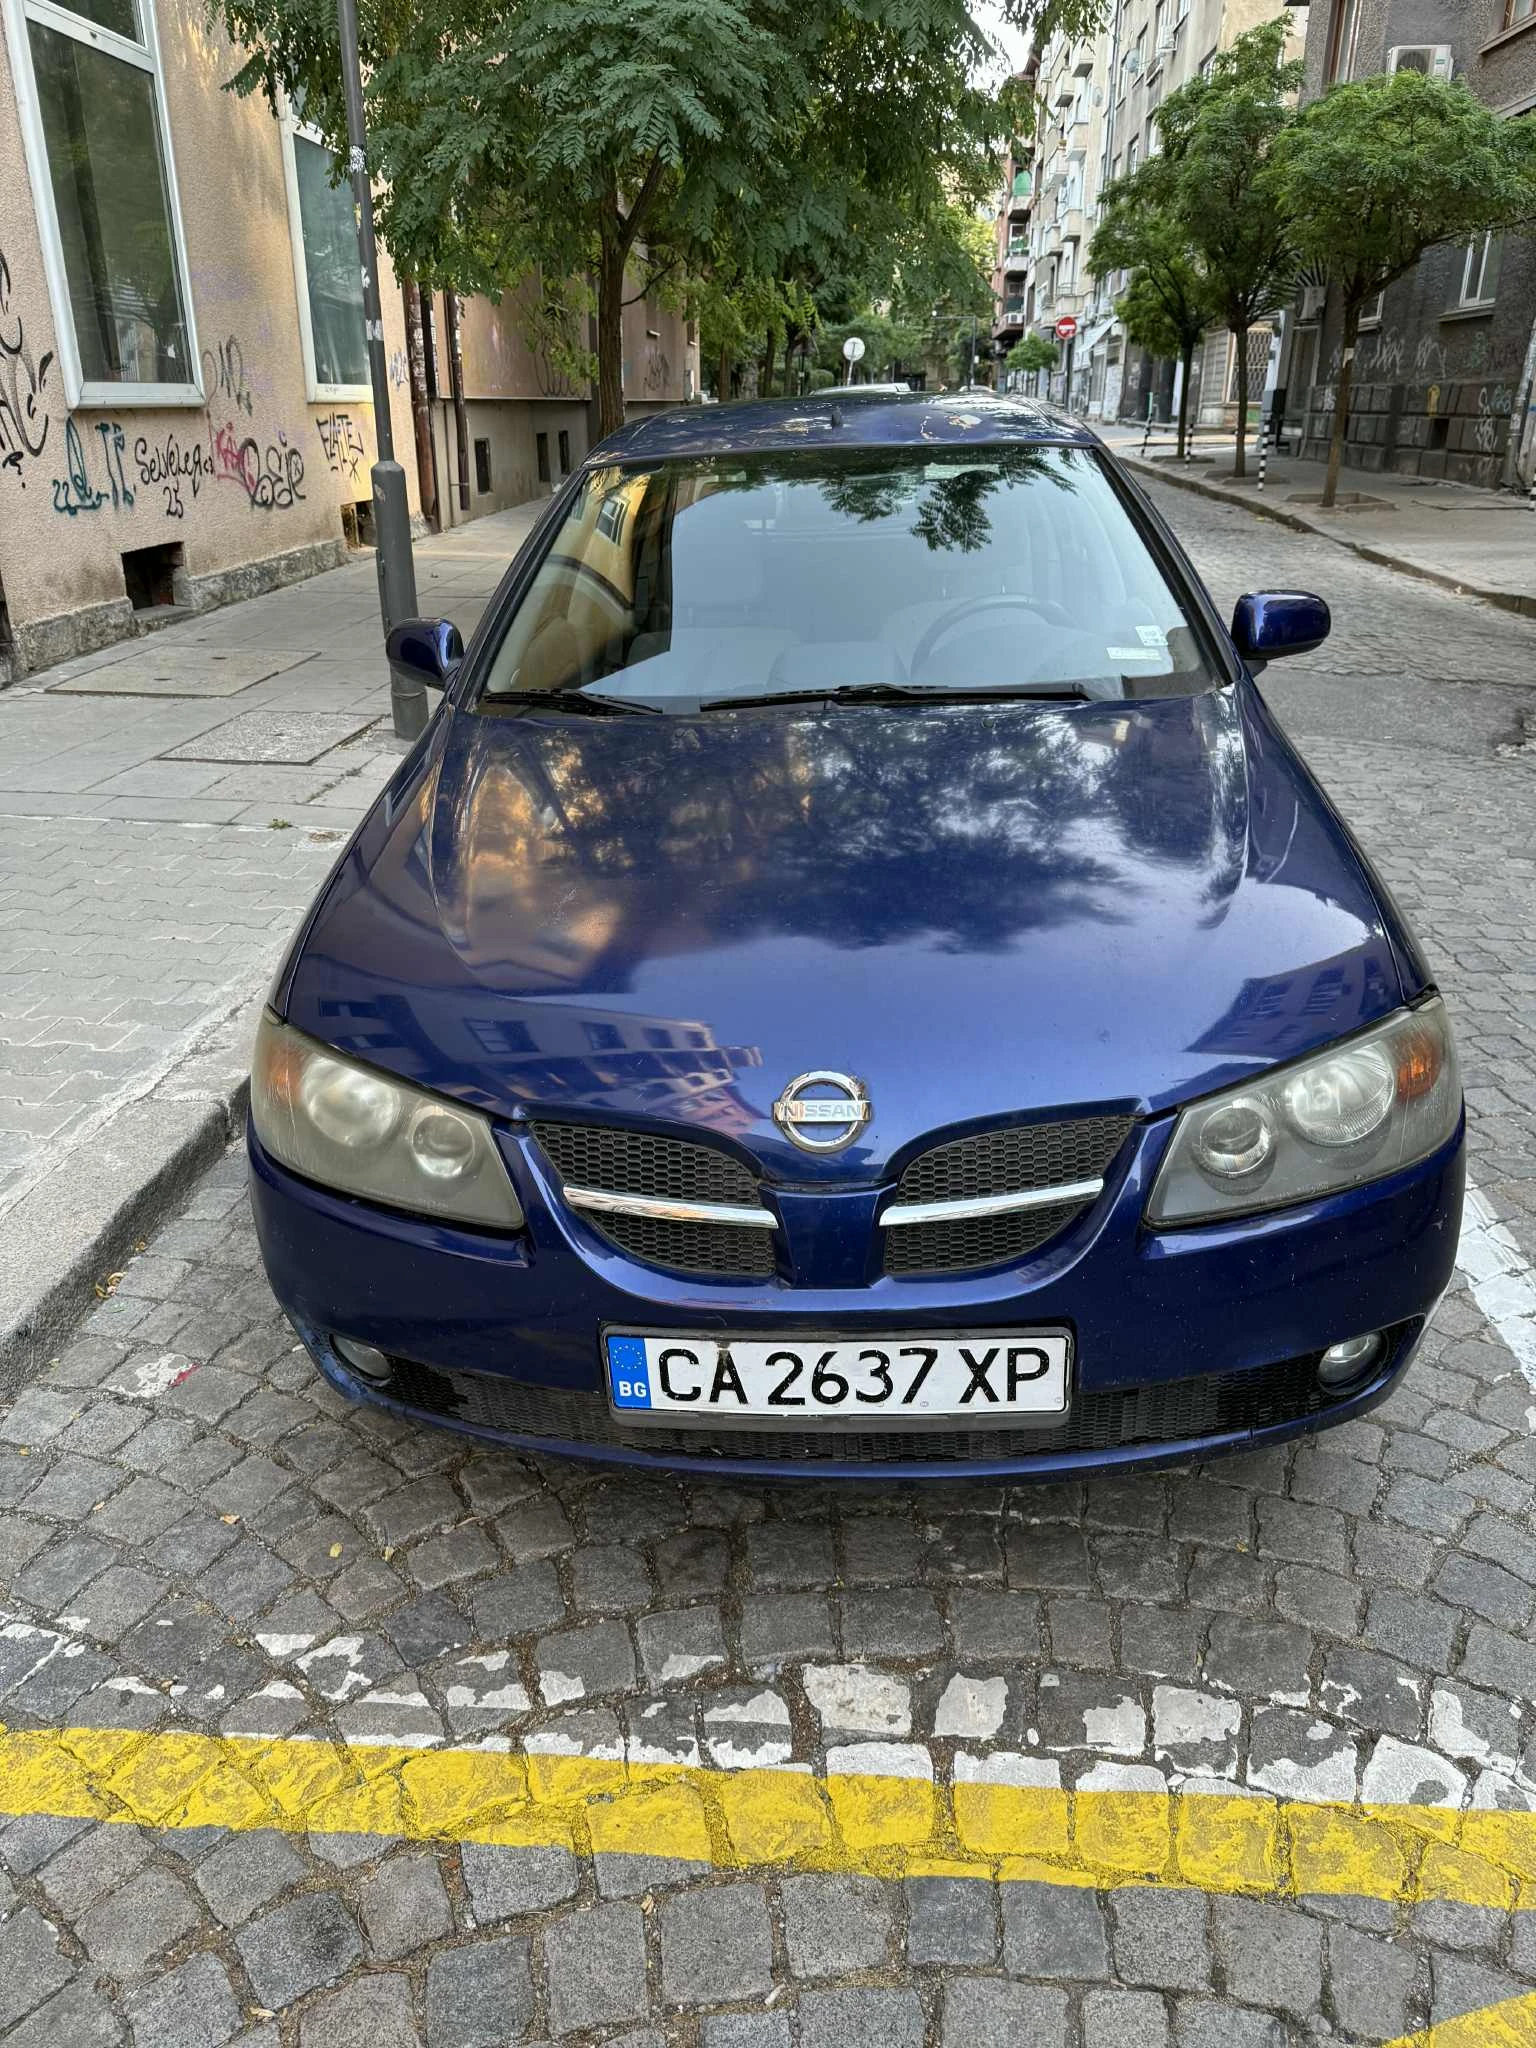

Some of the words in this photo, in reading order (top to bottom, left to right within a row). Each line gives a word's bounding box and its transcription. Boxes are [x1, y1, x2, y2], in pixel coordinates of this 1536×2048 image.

[783, 1102, 862, 1119] NISSAN
[658, 1347, 749, 1405] CA
[765, 1347, 939, 1406] 2637
[958, 1346, 1051, 1404] XP
[618, 1380, 647, 1398] BG
